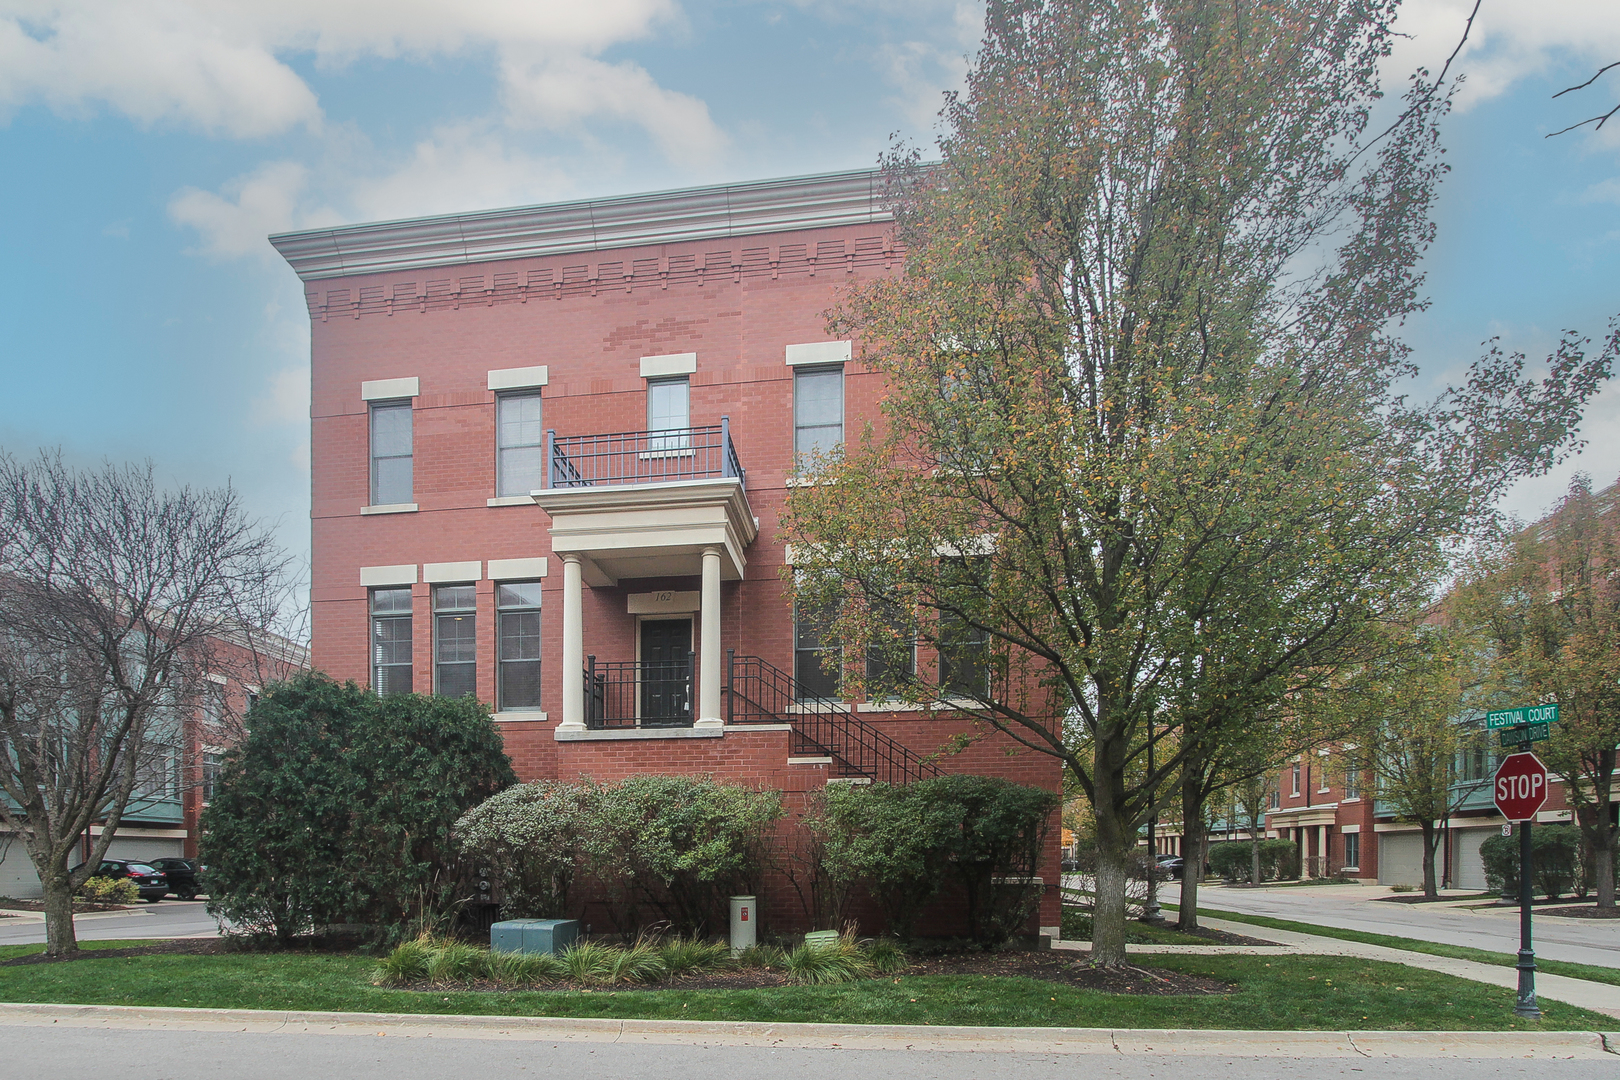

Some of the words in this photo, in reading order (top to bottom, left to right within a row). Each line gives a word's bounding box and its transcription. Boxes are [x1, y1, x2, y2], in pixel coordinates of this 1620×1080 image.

[655, 592, 672, 602] 162
[1489, 710, 1526, 726] FESTIVAL
[1528, 706, 1556, 722] COURT
[1528, 724, 1548, 740] DRIVE
[1497, 773, 1543, 801] STOP
